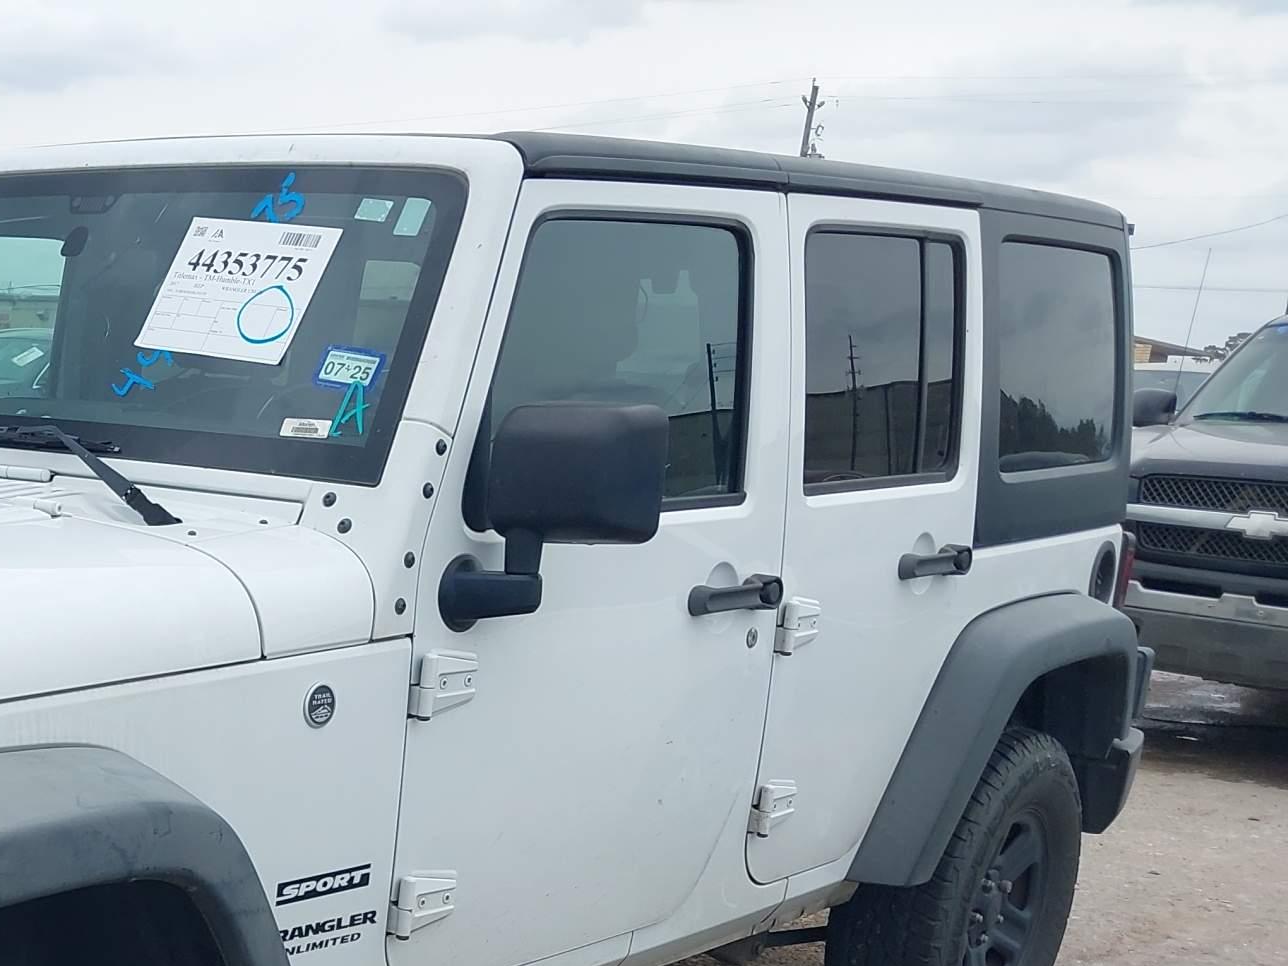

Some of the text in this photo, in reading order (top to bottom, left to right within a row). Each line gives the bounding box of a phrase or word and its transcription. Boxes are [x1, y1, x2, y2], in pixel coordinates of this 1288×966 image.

[188, 249, 309, 282] 44353775
[324, 361, 371, 381] 07 25
[279, 870, 366, 897] SPORT
[279, 910, 377, 942] RANGLER
[285, 932, 361, 956] NLIMITED
